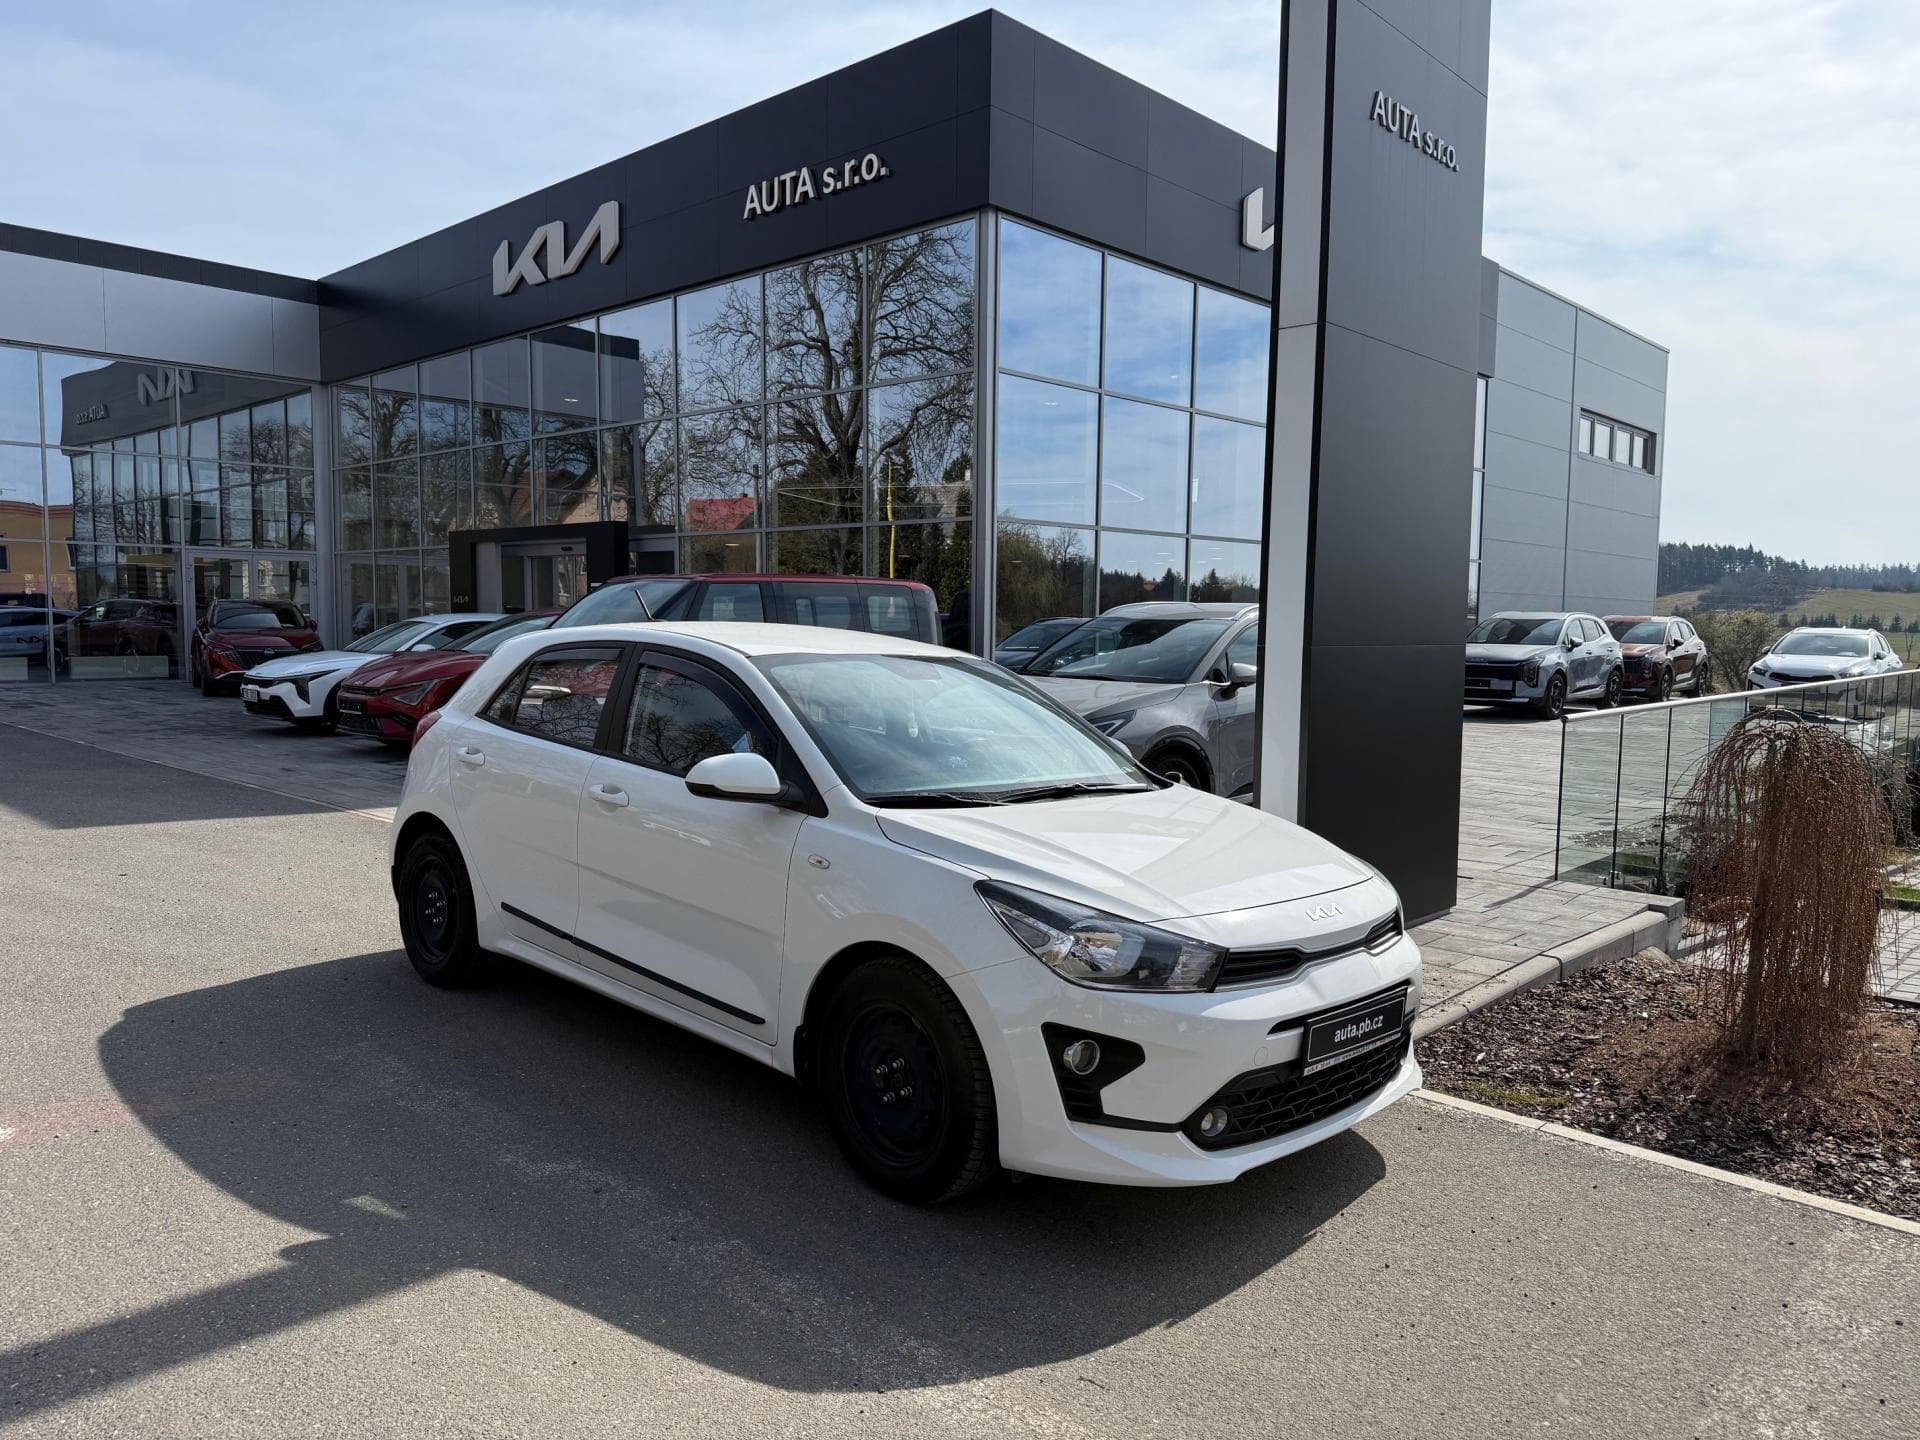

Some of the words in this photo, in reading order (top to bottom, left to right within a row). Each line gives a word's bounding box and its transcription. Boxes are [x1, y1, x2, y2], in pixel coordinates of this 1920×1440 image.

[1371, 90, 1421, 148] AUTA
[1424, 130, 1459, 172] s.r.o.
[744, 165, 814, 220] AUTA
[822, 152, 890, 194] s.r.o.
[492, 200, 622, 296] KIA
[1306, 903, 1344, 921] KIA
[1334, 1015, 1384, 1042] auta.pb.cz
